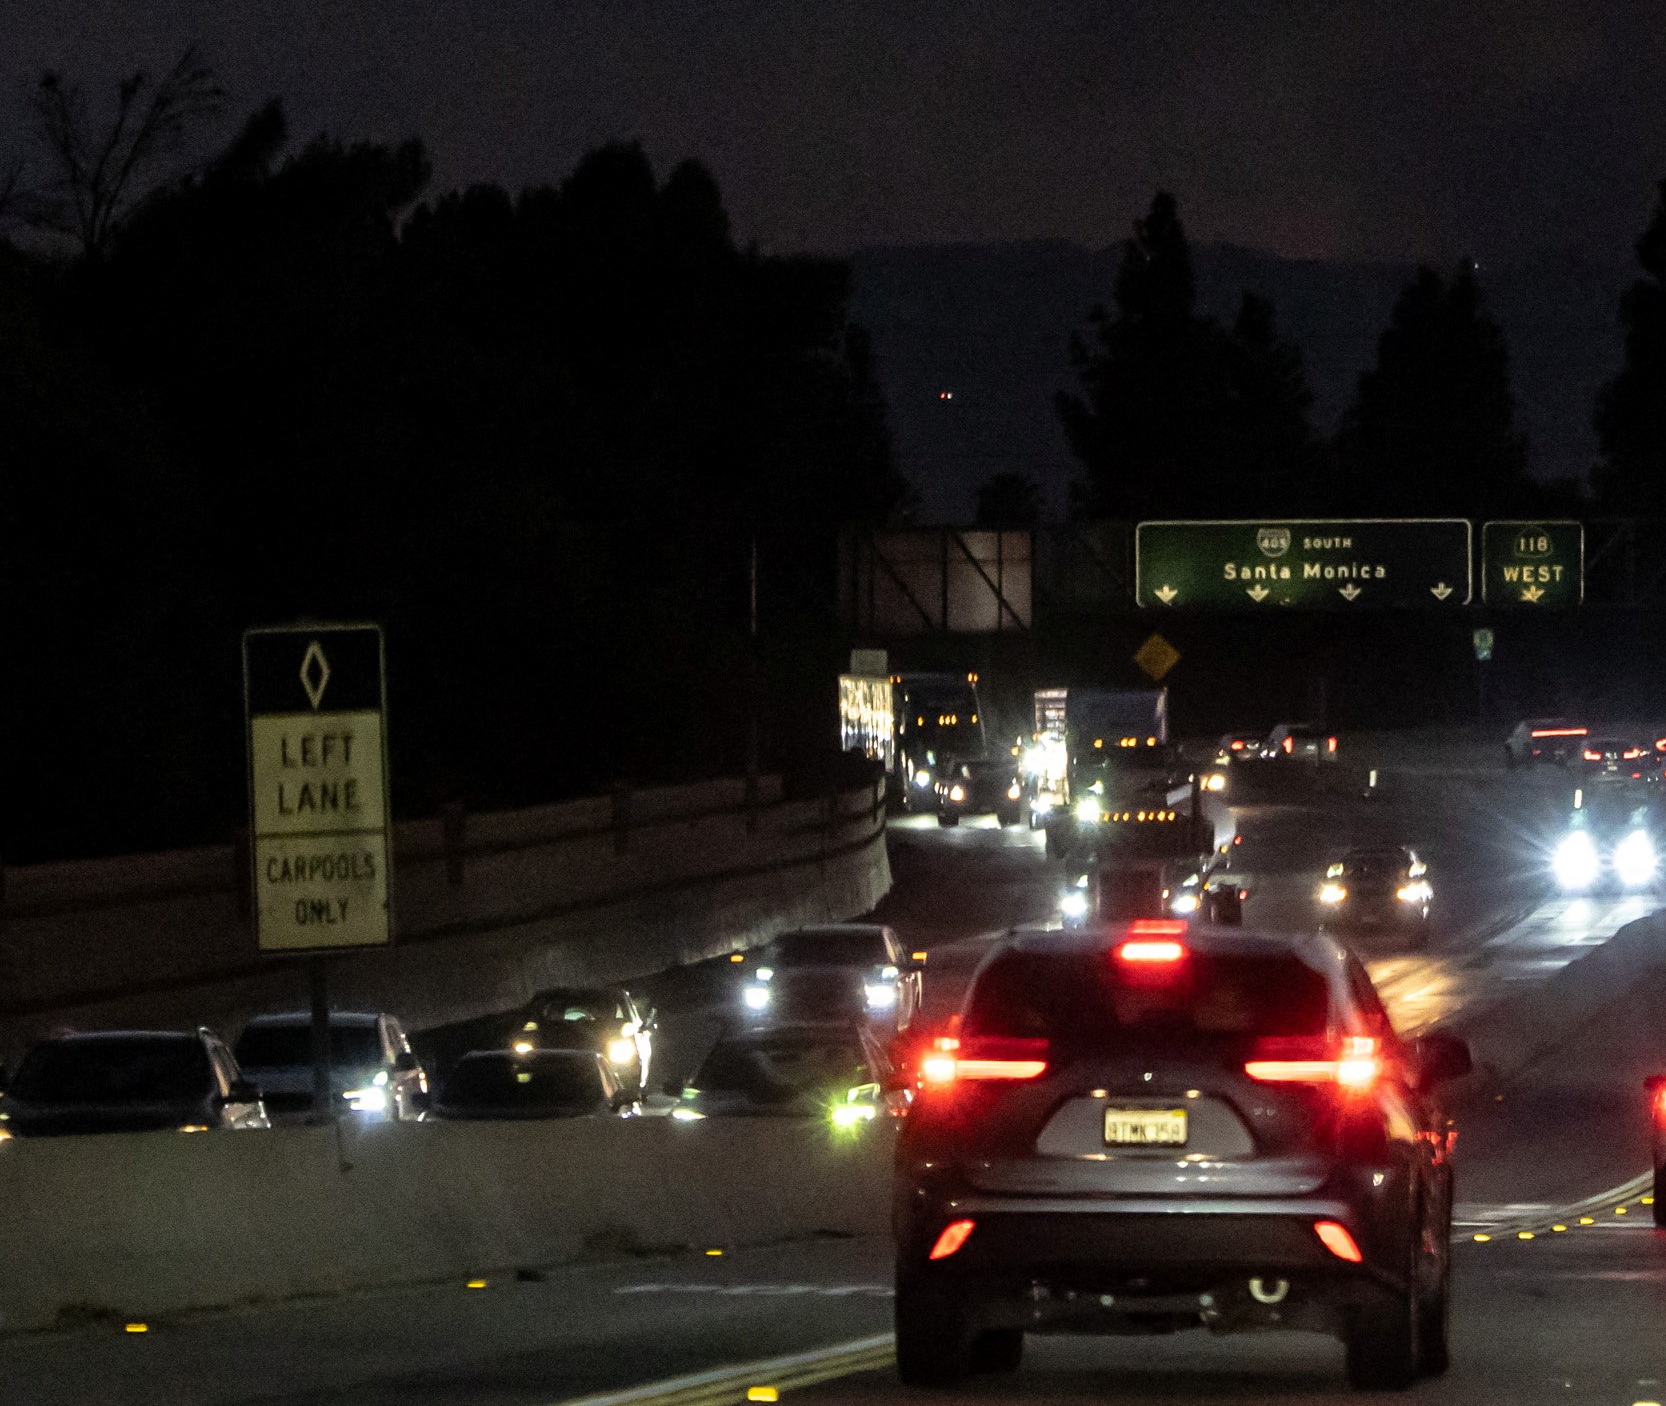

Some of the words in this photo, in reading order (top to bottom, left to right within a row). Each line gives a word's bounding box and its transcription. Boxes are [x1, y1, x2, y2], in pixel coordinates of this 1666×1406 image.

[1303, 537, 1352, 549] SOUTH
[1520, 536, 1548, 552] 118
[1224, 562, 1292, 580] Santa
[1303, 561, 1386, 580] Monica
[1503, 564, 1563, 582] WEST
[281, 733, 355, 769] LEFT
[277, 778, 361, 816] LANE
[265, 851, 377, 885] CARPOOLS
[294, 897, 350, 927] ONLY
